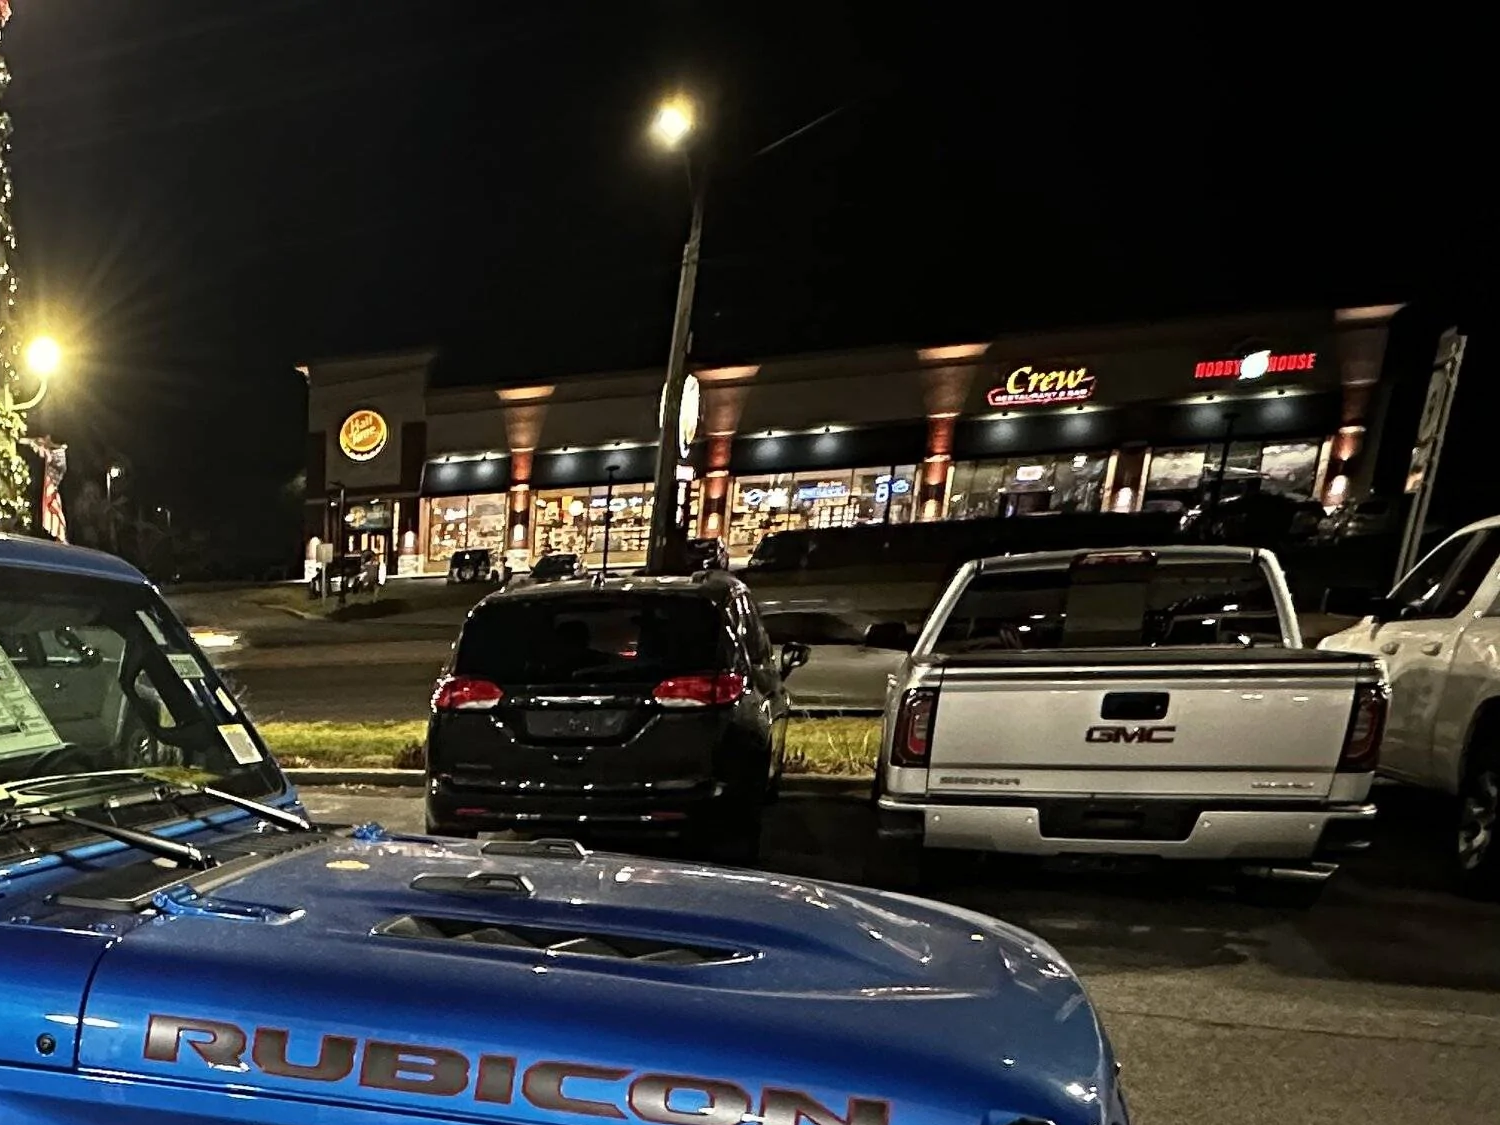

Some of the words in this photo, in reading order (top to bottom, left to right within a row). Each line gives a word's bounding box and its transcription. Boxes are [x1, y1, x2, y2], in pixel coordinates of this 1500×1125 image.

[1267, 353, 1317, 373] HOUSE
[1006, 366, 1087, 395] Crew
[1085, 726, 1176, 743] GMC
